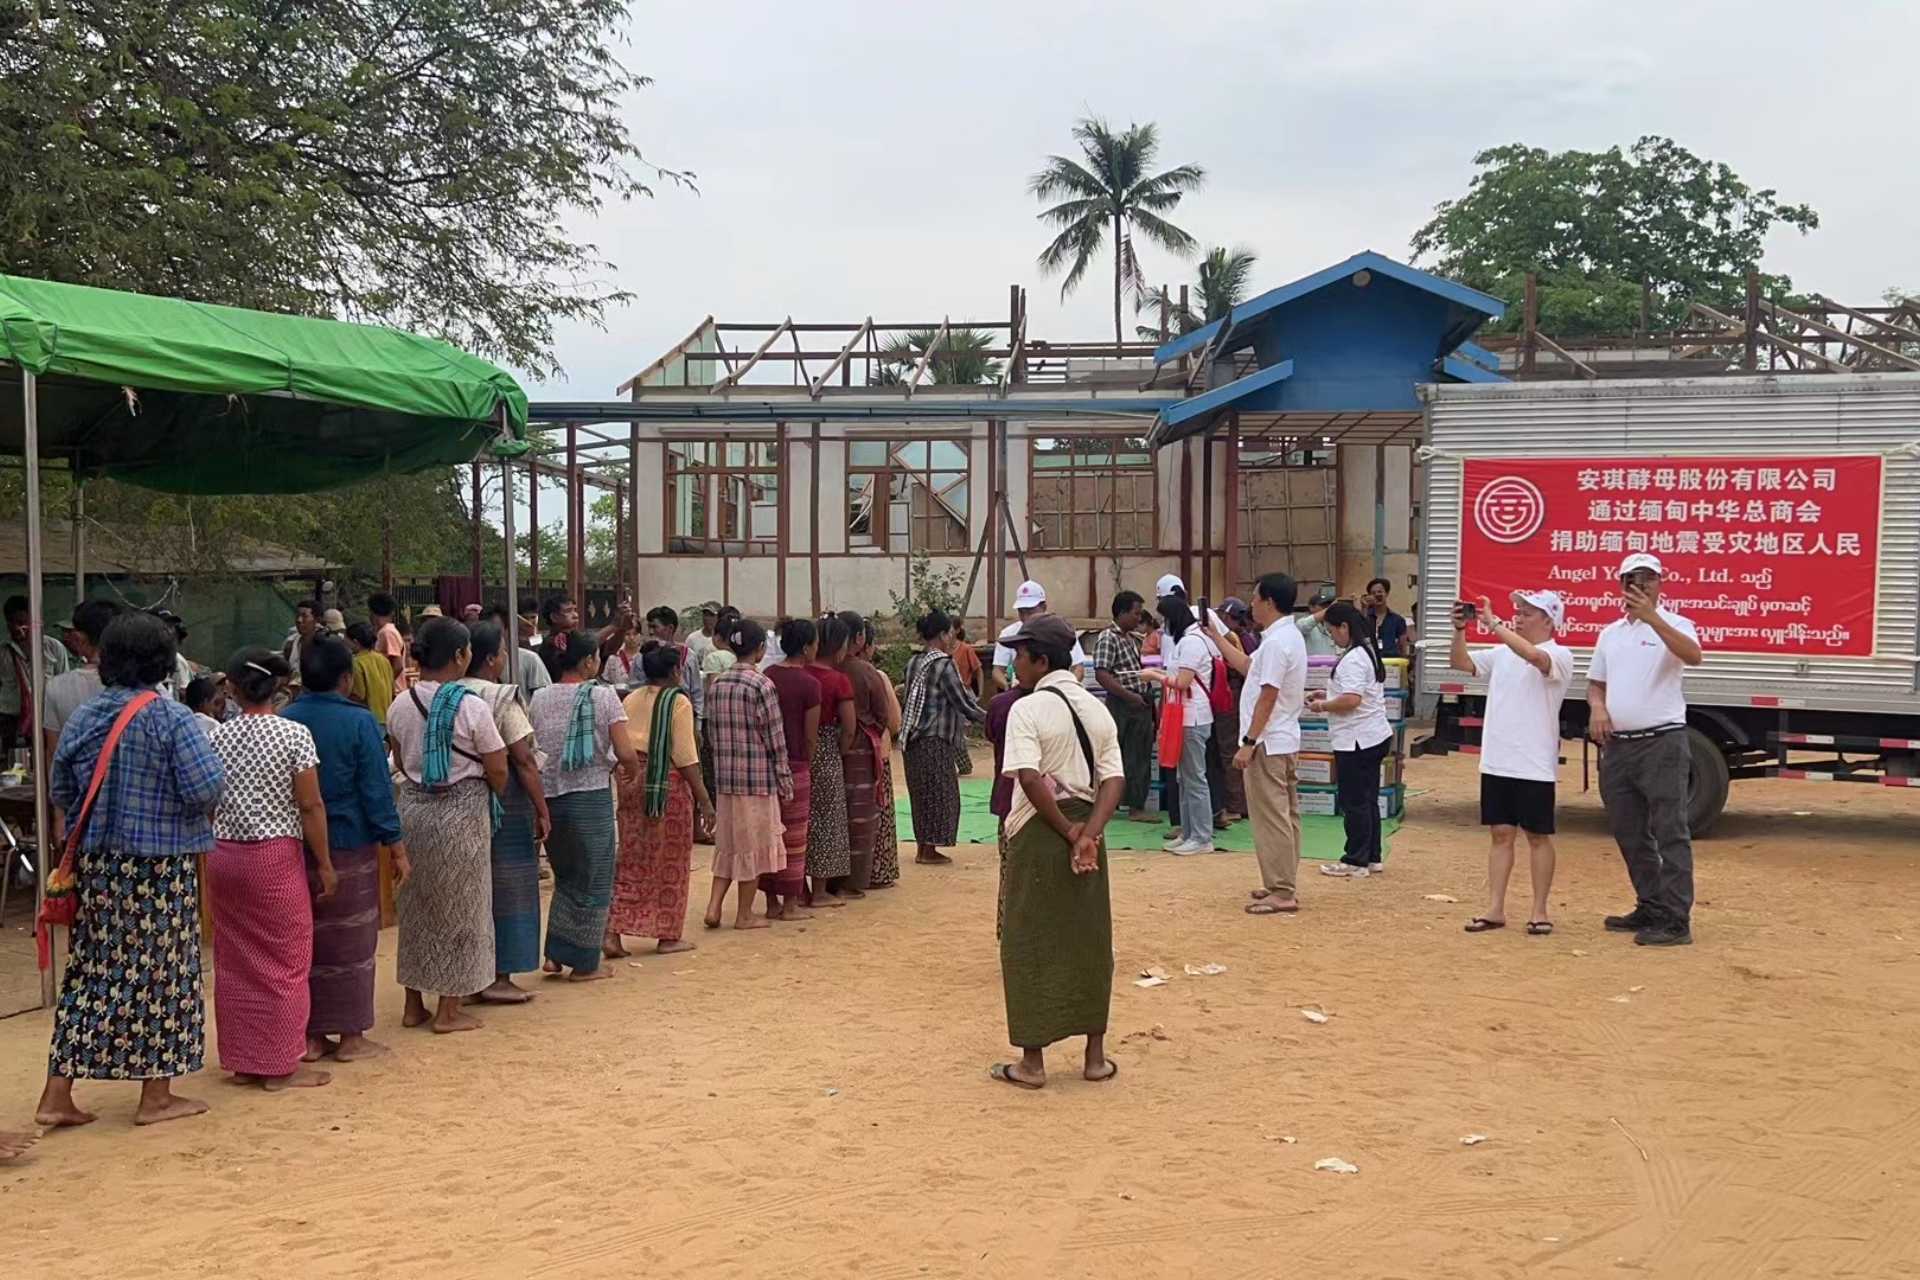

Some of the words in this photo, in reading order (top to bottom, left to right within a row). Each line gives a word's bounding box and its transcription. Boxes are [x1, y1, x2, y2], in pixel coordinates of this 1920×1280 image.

[1577, 468, 1836, 491] 安琪酵母股份有限公司
[1588, 499, 1821, 523] 通过缅甸中华总商会
[1550, 530, 1861, 555] 捐助缅甸地震受灾地区人民
[1548, 565, 1596, 583] Angel
[1698, 567, 1734, 583] Ltd.
[1740, 568, 1772, 589] သည်
